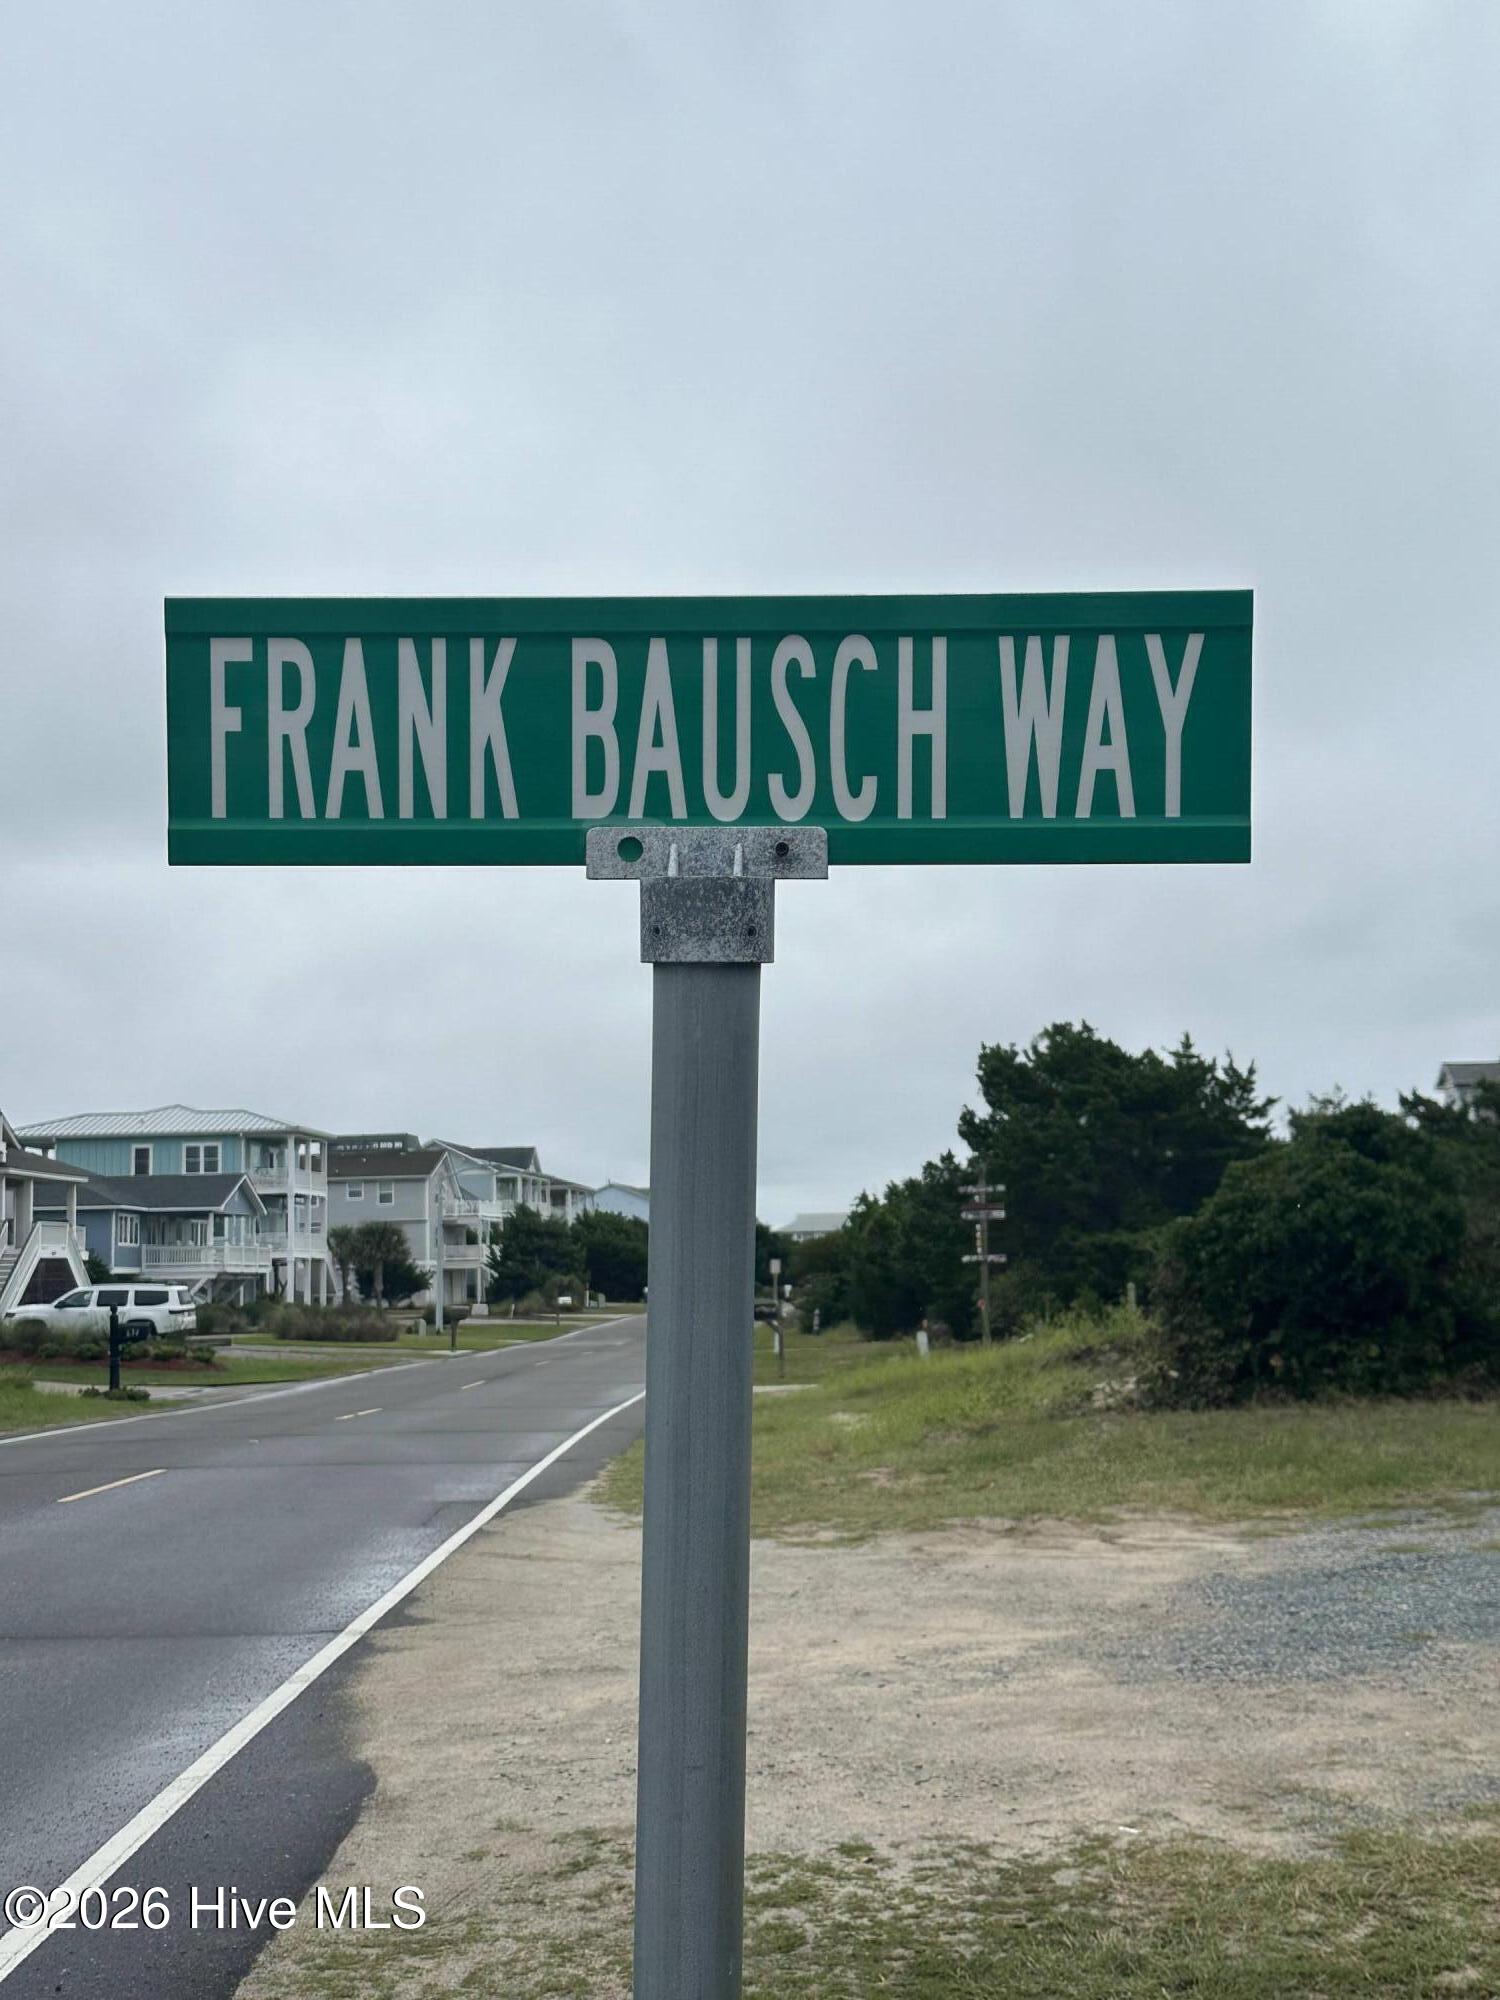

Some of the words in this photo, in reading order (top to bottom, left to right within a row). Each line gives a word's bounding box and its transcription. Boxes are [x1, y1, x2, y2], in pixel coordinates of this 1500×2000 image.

[208, 636, 519, 820] FRANK
[570, 634, 949, 823] BAUSCH
[997, 633, 1205, 819] WAY
